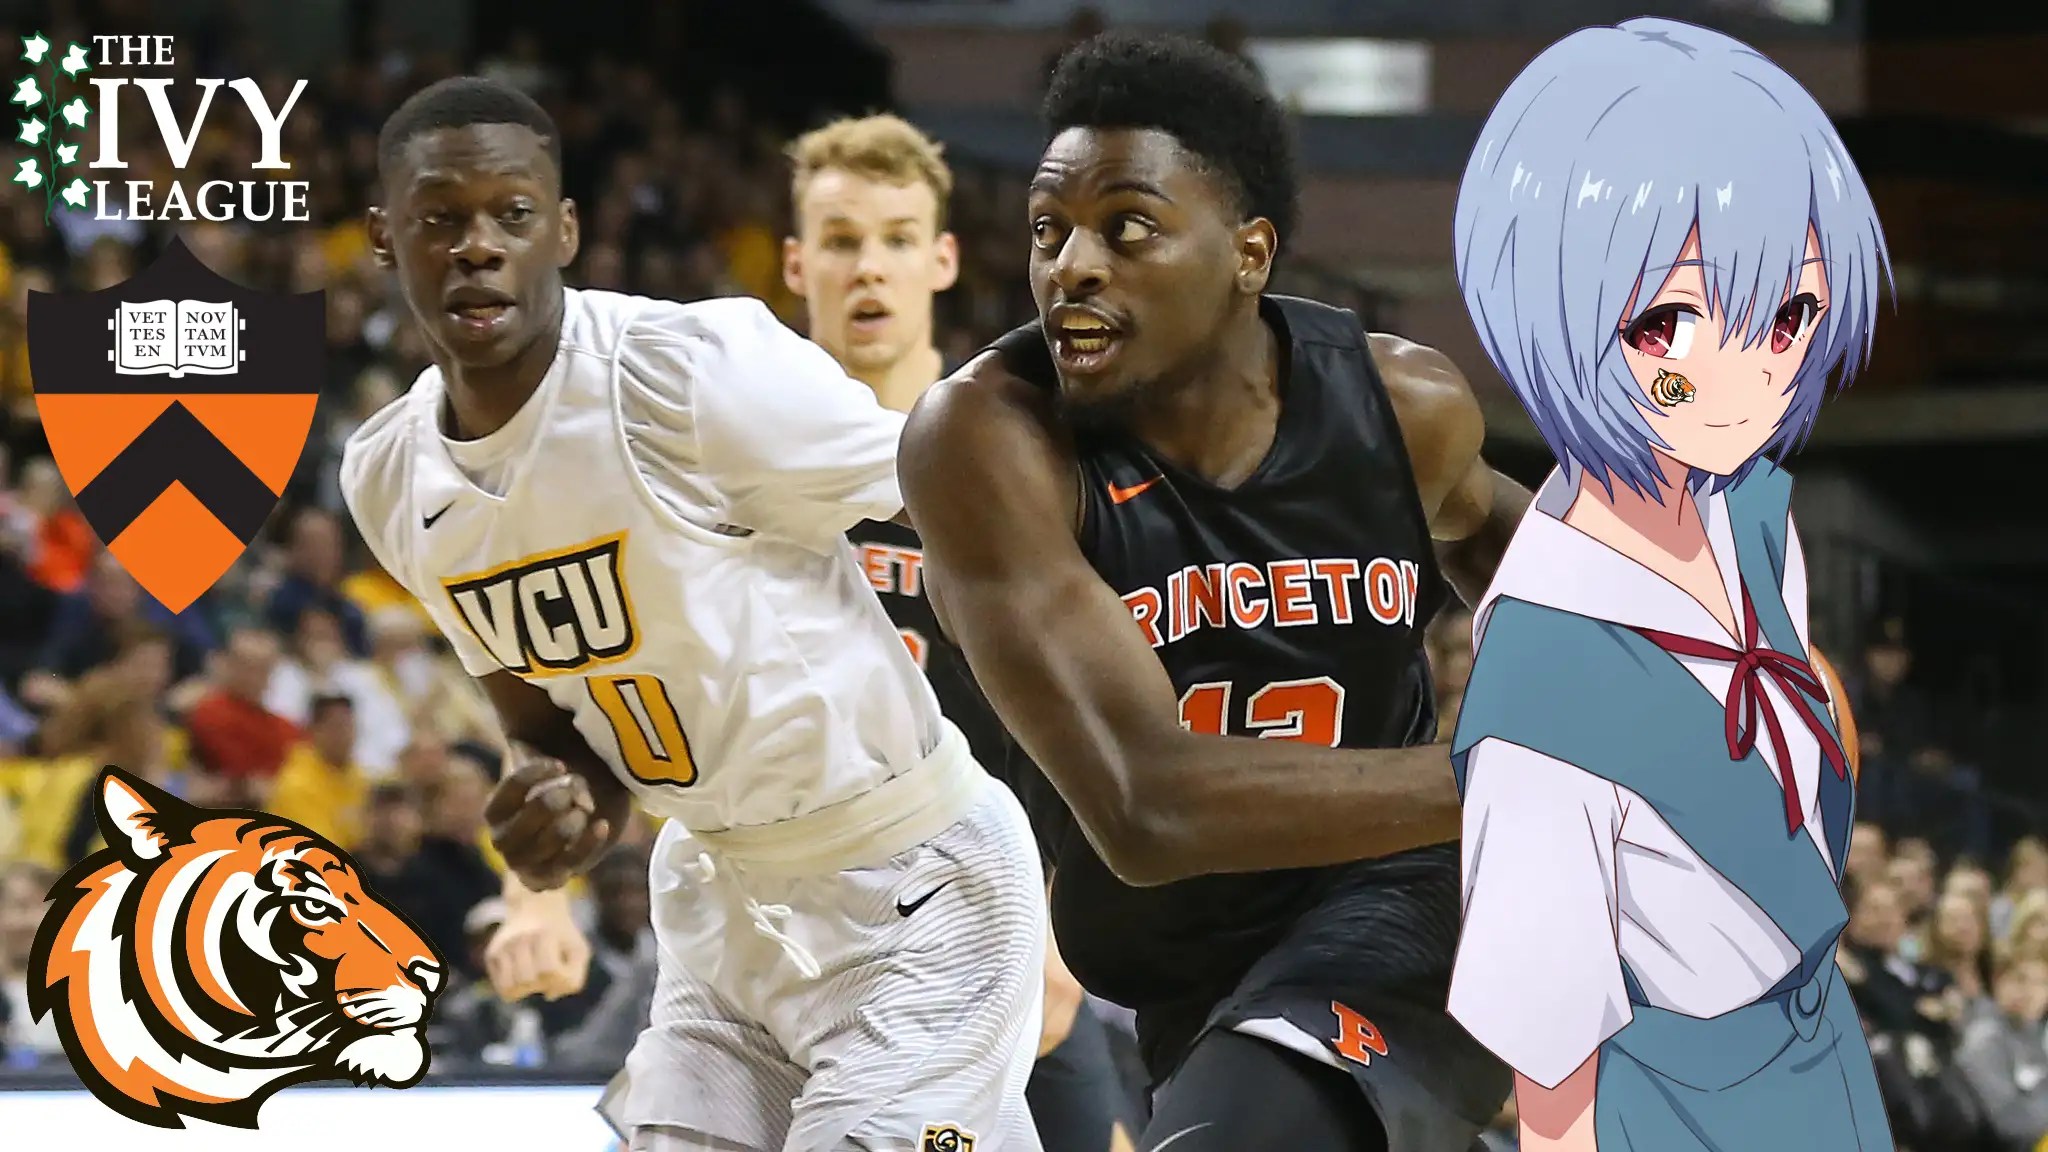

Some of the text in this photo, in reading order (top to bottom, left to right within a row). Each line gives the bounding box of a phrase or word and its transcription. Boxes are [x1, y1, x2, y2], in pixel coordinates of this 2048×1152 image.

[444, 538, 634, 673] VCU
[585, 674, 698, 787] 0
[1330, 1000, 1389, 1066] P
